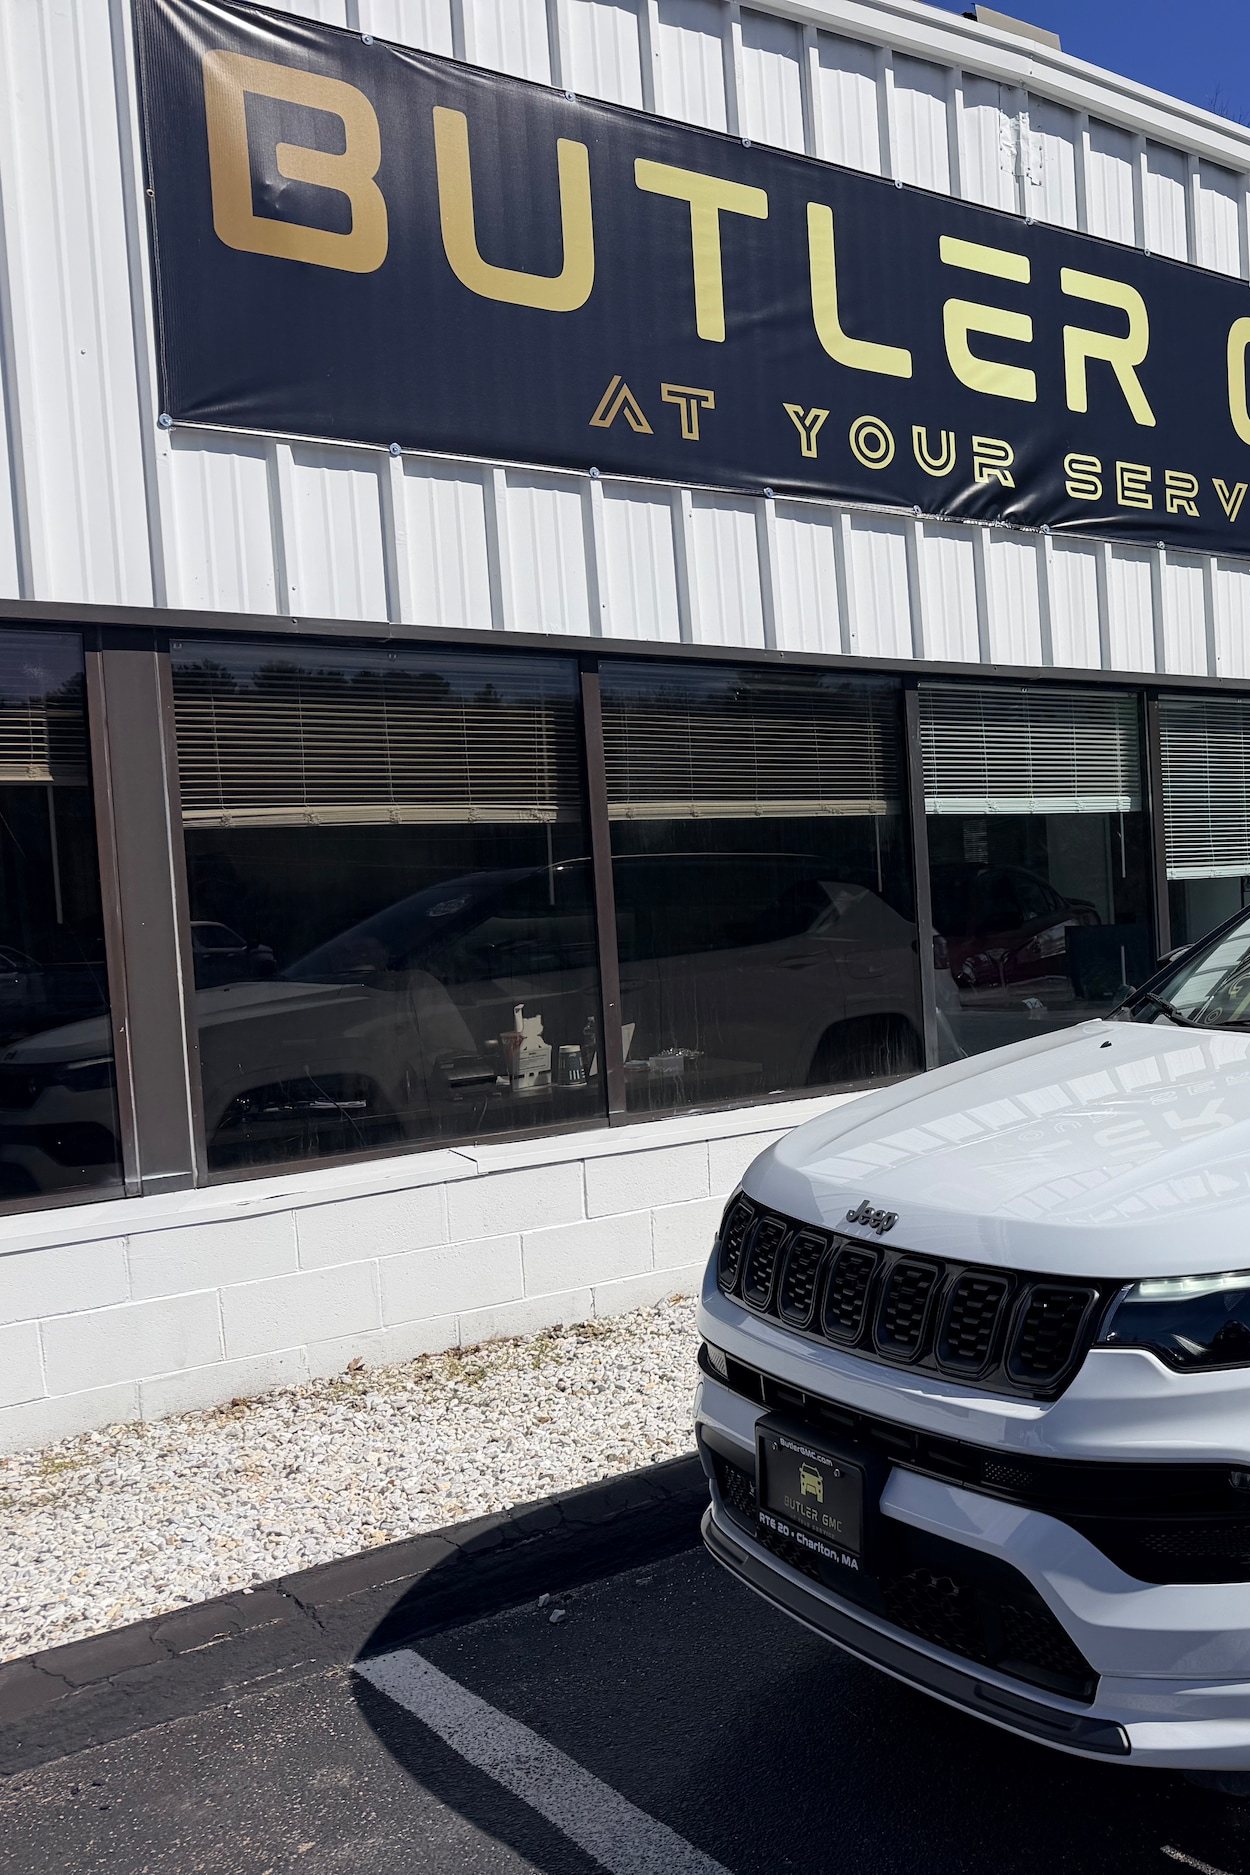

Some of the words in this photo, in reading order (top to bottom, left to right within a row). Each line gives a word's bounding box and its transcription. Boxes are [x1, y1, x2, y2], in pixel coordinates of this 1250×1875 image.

[203, 48, 1157, 428] BUTLER
[588, 374, 715, 441] AT
[783, 401, 1015, 489] YOUR
[845, 1199, 900, 1235] Jeep
[779, 1437, 833, 1467] ButlerGMC.com
[784, 1495, 818, 1522] BUTLER
[822, 1514, 842, 1533] GMC
[796, 1532, 840, 1563] Charlton,
[841, 1553, 859, 1571] MA
